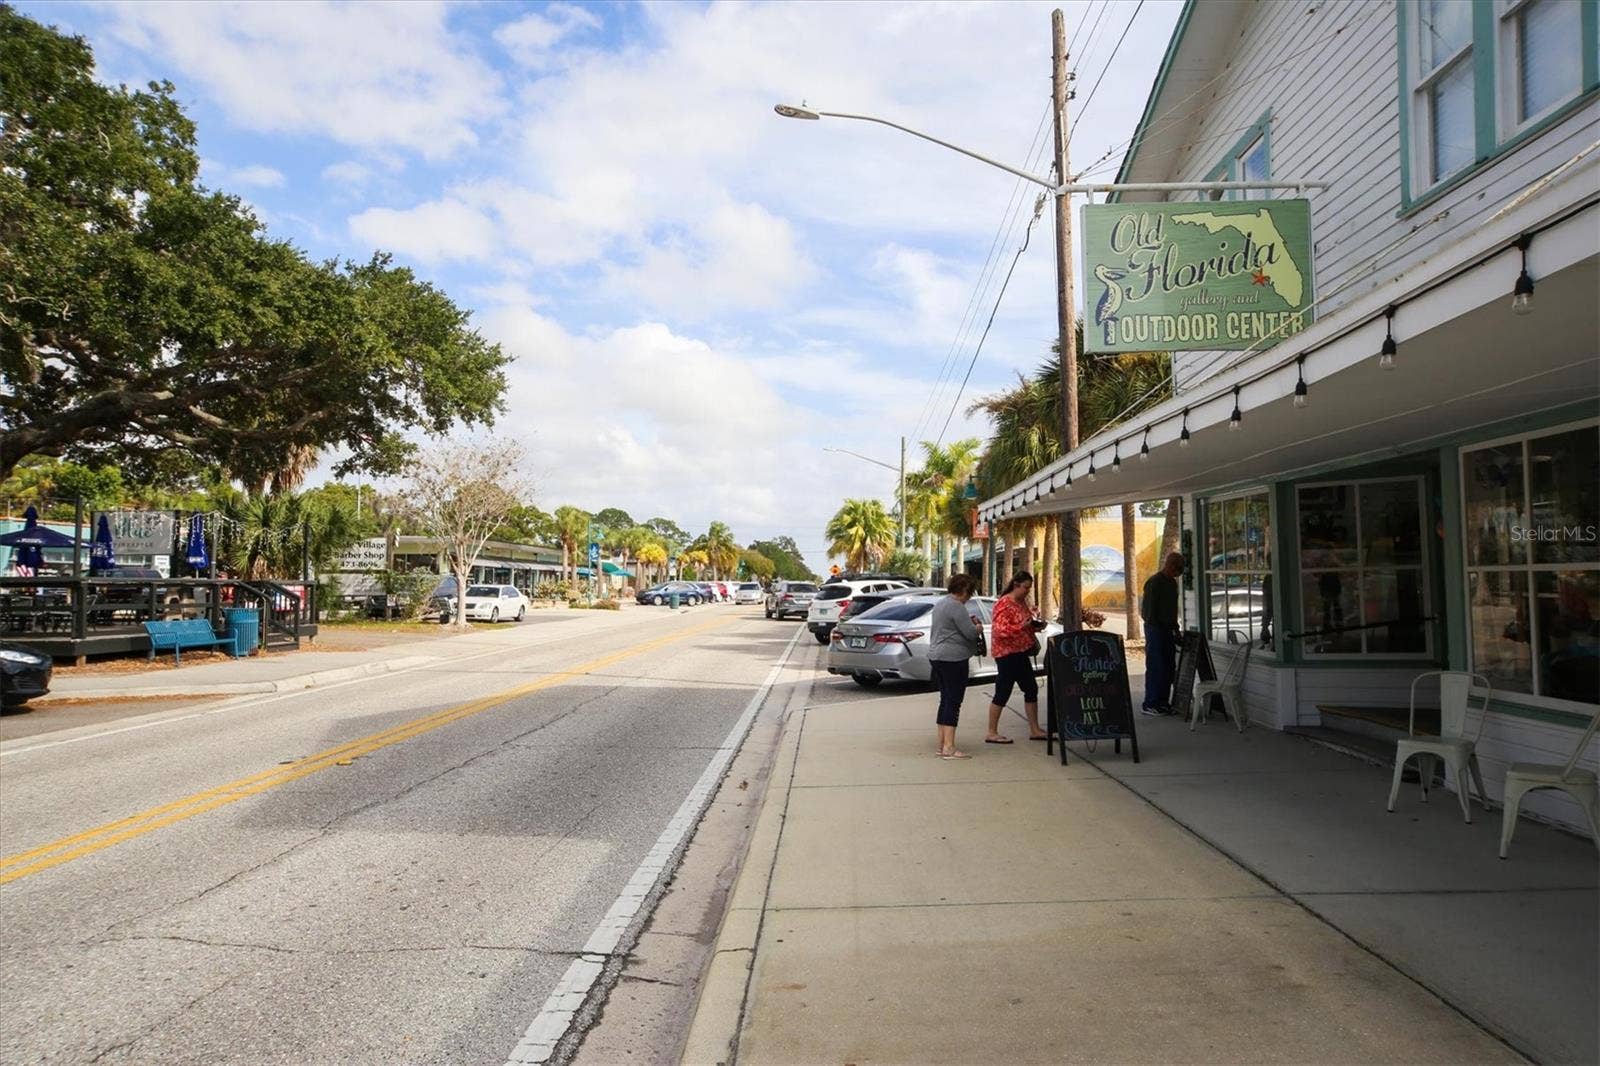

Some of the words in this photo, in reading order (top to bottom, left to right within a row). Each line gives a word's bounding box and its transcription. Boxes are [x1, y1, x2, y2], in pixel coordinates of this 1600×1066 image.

[1110, 211, 1167, 254] Old
[1124, 231, 1281, 302] Florida
[1178, 289, 1228, 312] gallery
[1232, 290, 1260, 305] and
[1121, 313, 1219, 344] OUTDOOR
[1226, 311, 1305, 341] CENTER
[357, 541, 386, 549] Village
[363, 551, 385, 560] Shop
[1060, 636, 1090, 657] Old
